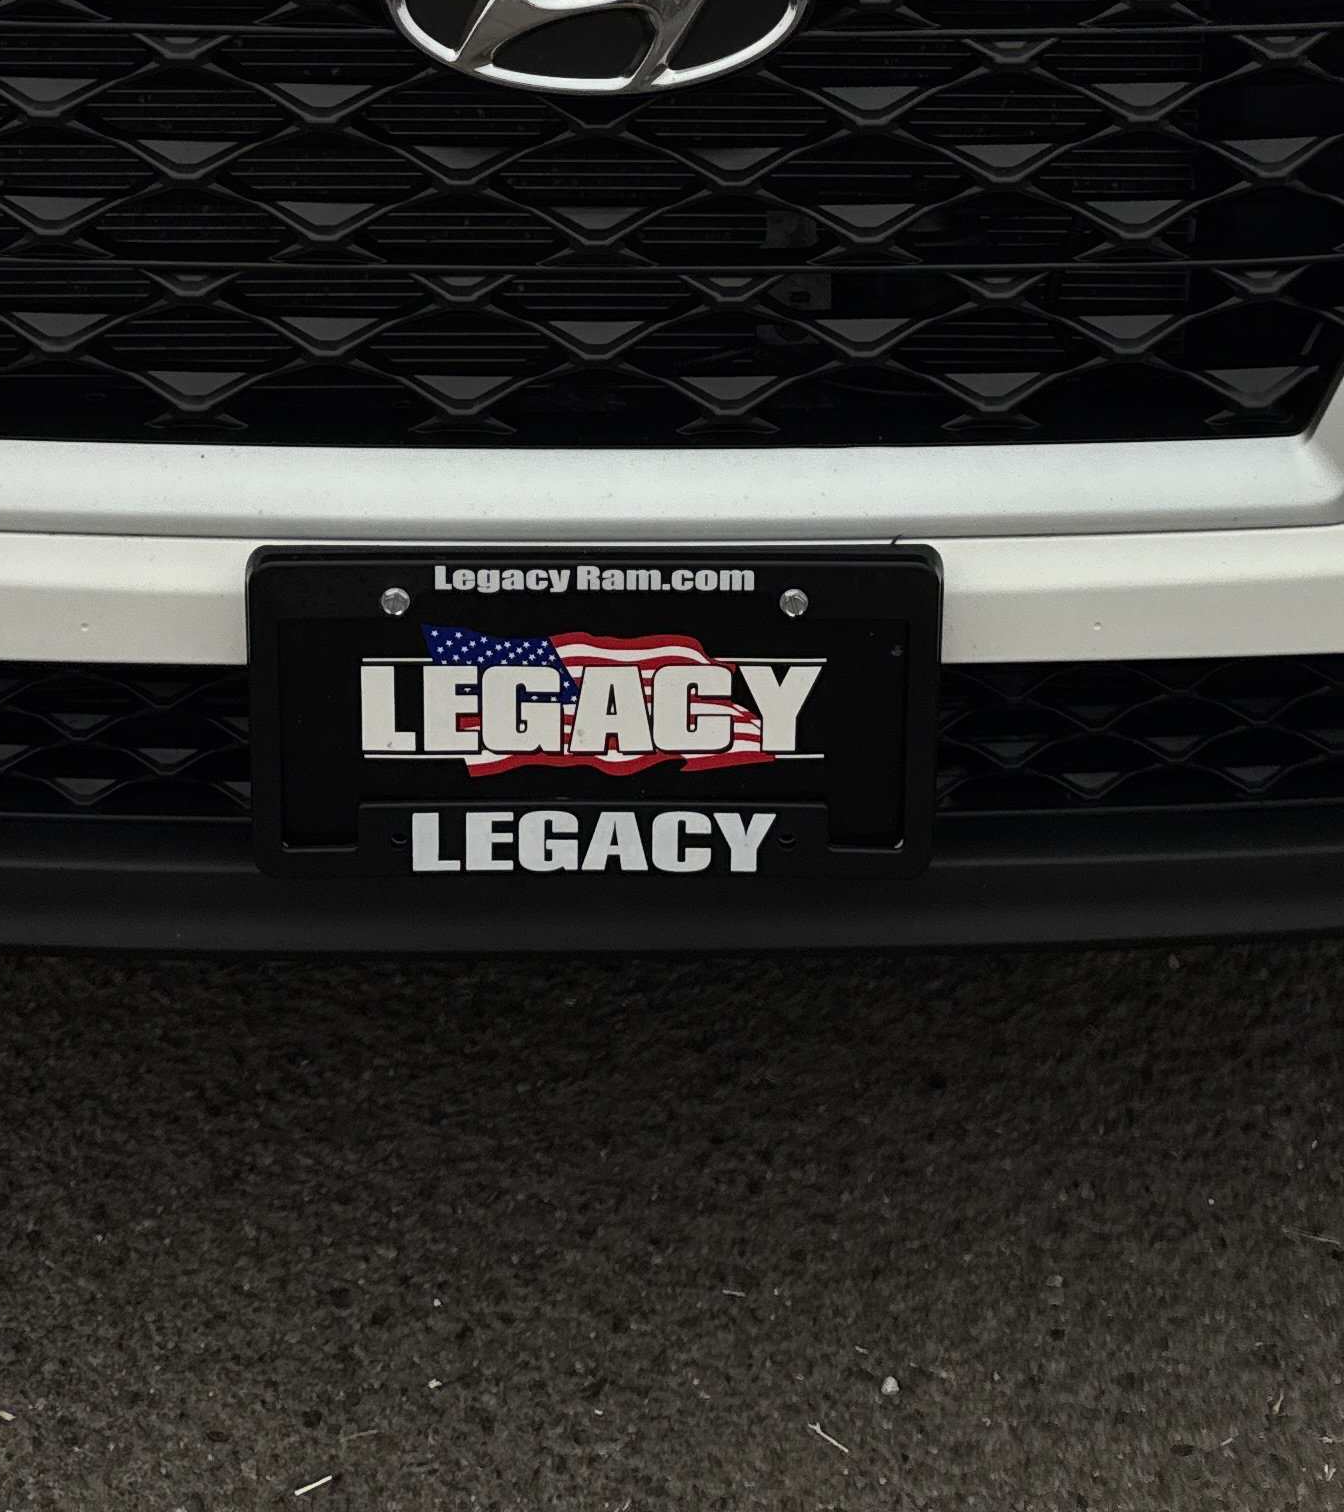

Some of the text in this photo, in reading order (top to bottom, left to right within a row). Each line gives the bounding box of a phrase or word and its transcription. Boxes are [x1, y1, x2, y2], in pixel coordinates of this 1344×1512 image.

[434, 565, 755, 593] Legacy Ram.com
[360, 665, 823, 753] LEGACY
[411, 811, 777, 874] LEGACY
